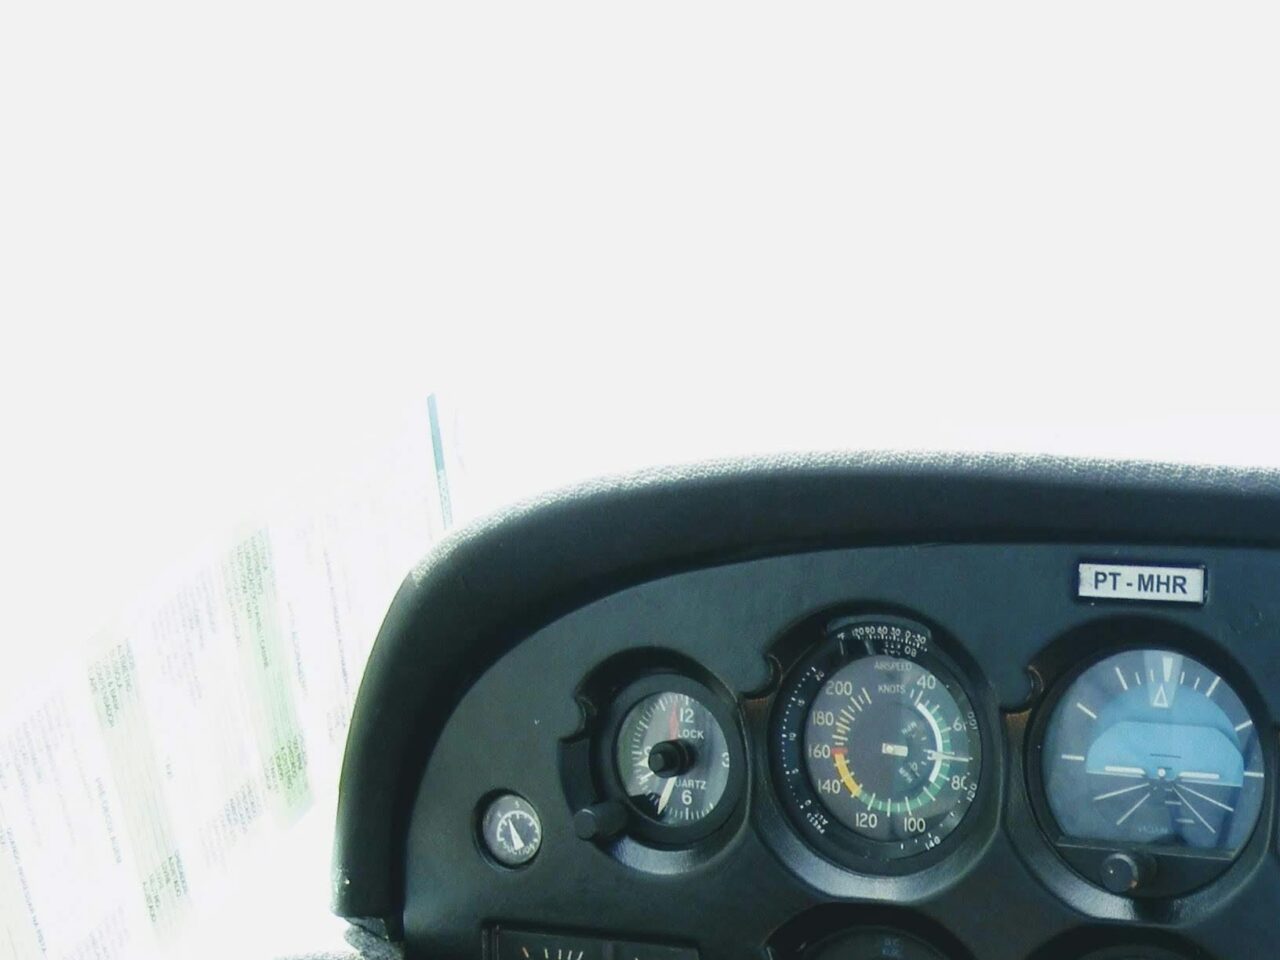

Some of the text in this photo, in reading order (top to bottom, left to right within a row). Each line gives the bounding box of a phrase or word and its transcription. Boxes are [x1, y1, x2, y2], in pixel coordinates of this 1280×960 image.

[826, 681, 853, 696] 200
[878, 684, 905, 694] KNOTS
[917, 675, 936, 689] 40
[679, 708, 694, 724] 12
[813, 711, 834, 726] 180
[808, 746, 830, 758] 160
[818, 782, 841, 794] 140
[681, 790, 692, 804] 6
[856, 813, 877, 828] 120
[904, 817, 926, 832] 100
